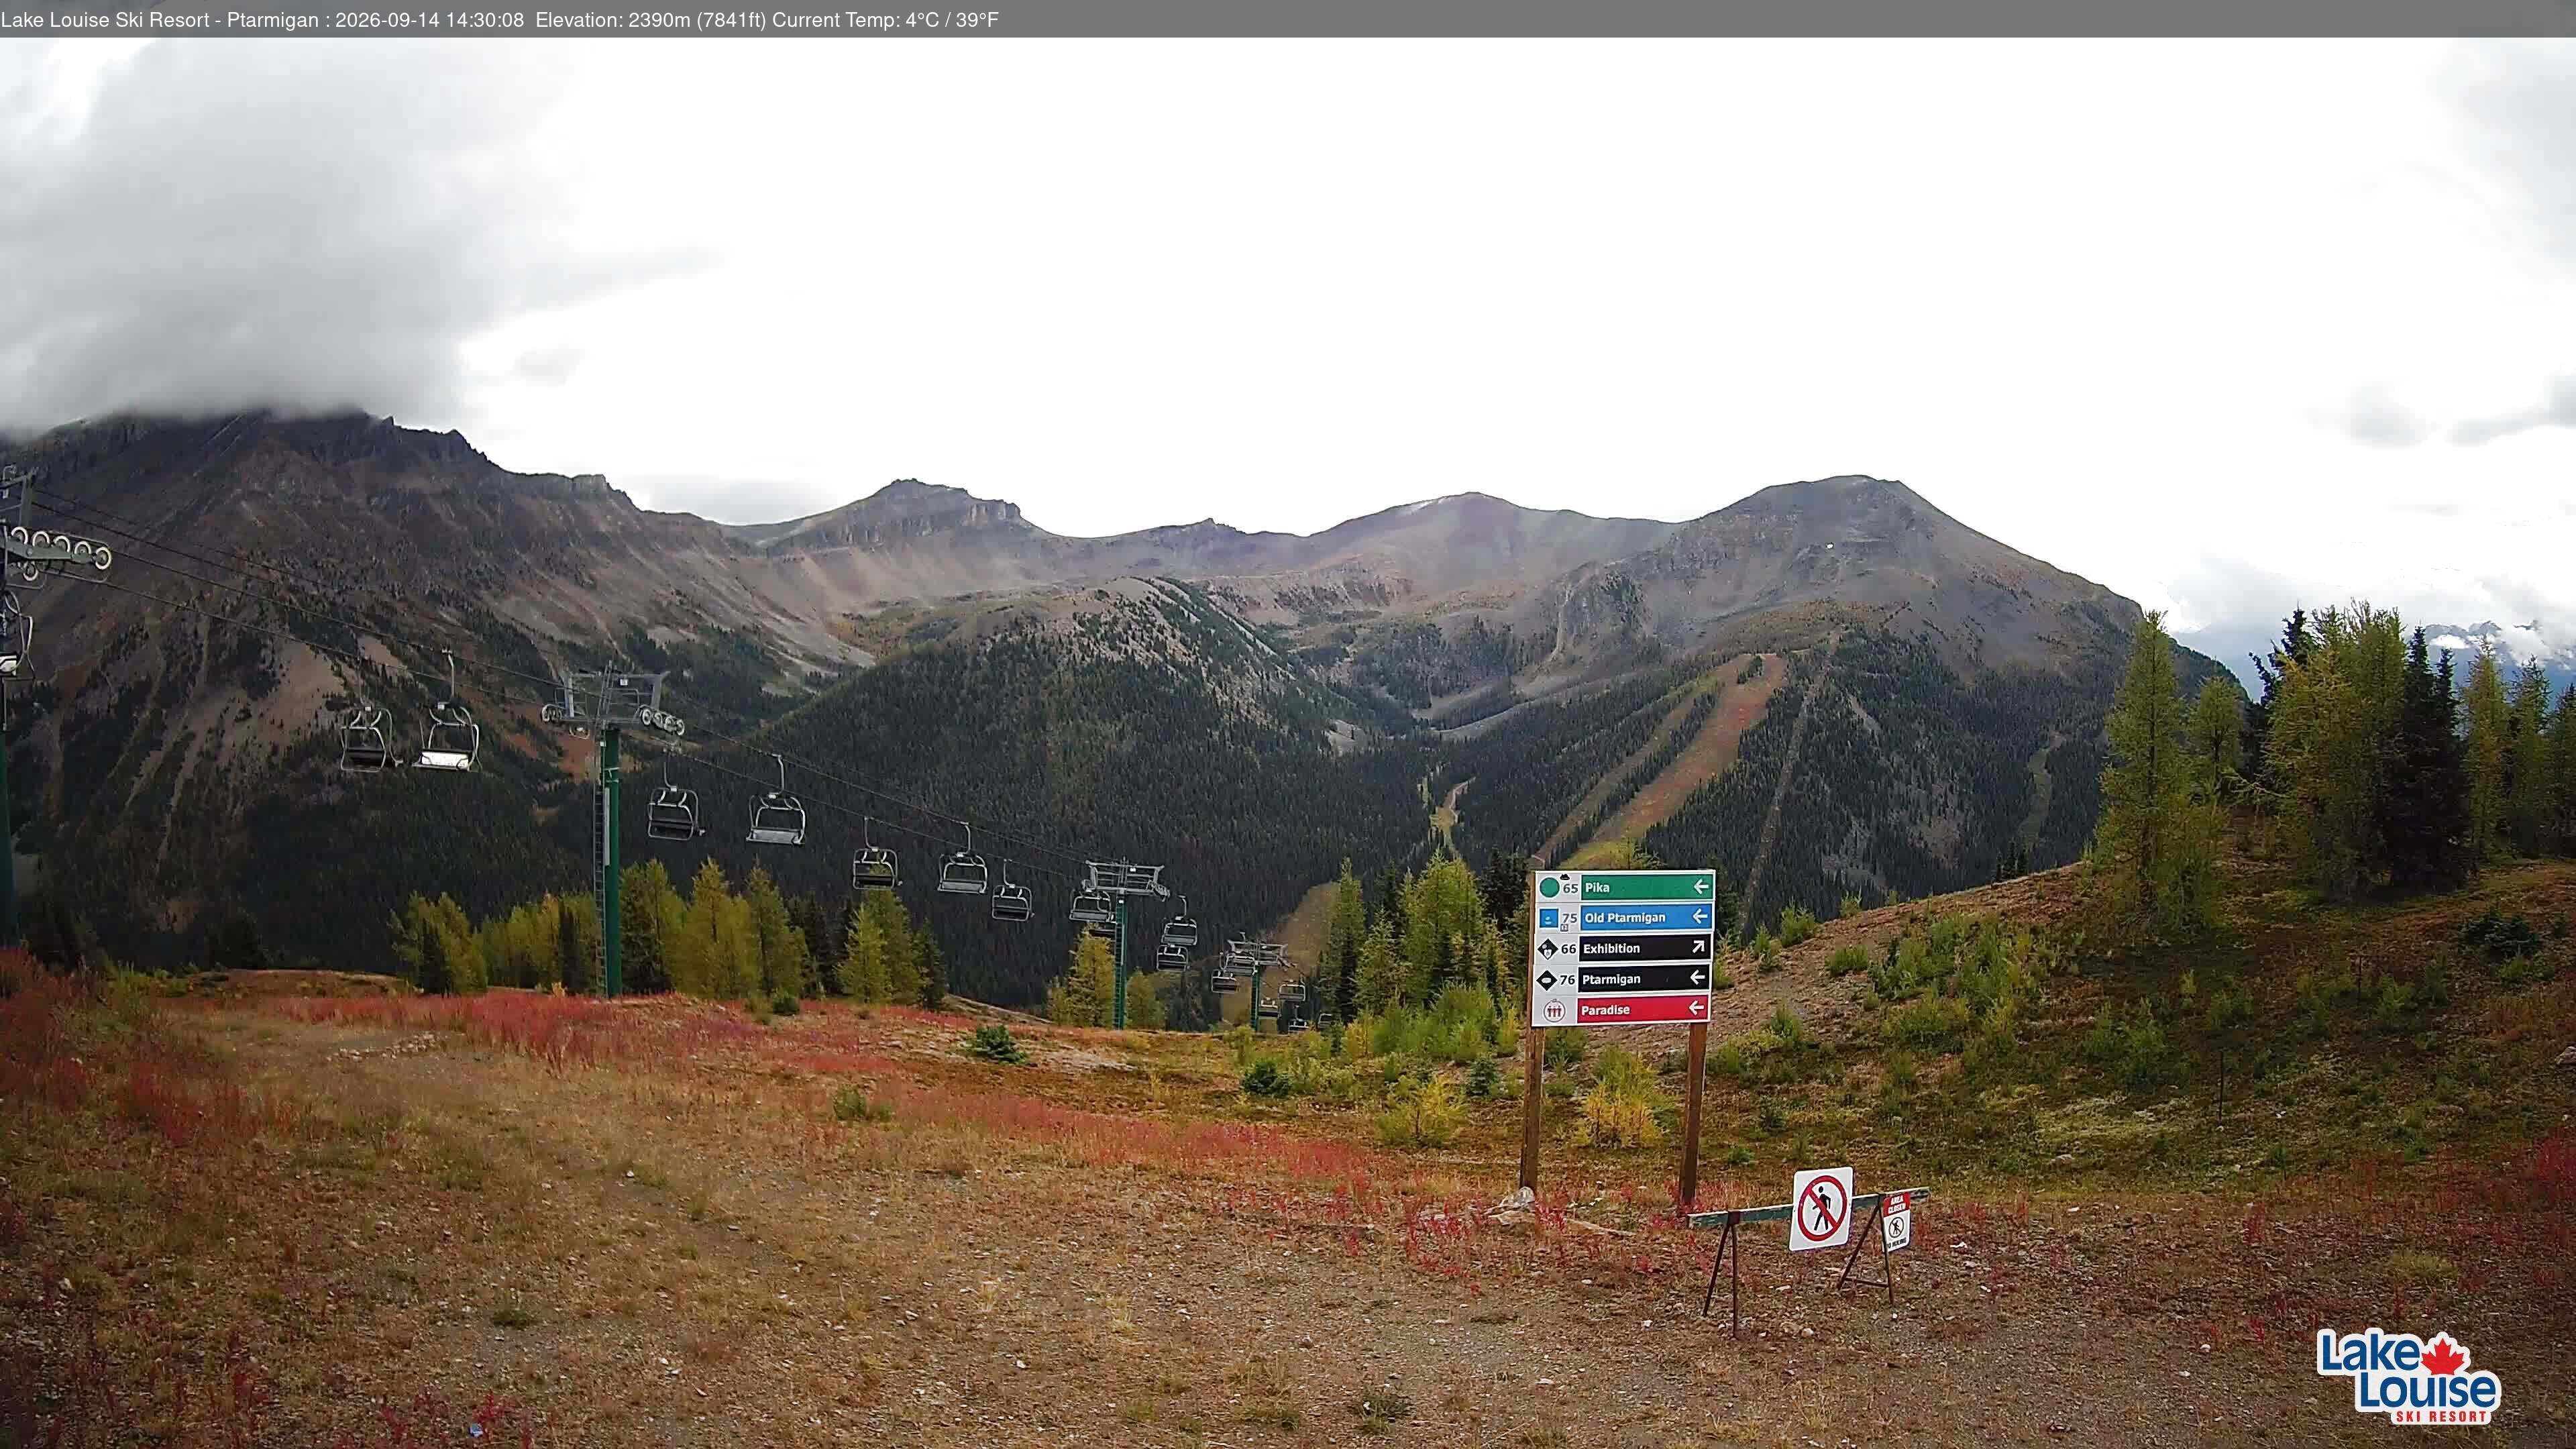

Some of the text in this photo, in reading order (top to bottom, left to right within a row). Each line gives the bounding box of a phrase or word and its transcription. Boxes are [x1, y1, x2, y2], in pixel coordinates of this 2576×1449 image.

[1563, 881, 1610, 894] 65 Pika
[1562, 911, 1666, 925] 75 Old Ptarmigan
[1561, 943, 1641, 955] 66 Exhibition
[1560, 974, 1641, 986] 76 Ptarmigan
[1581, 1005, 1630, 1016] Paradise
